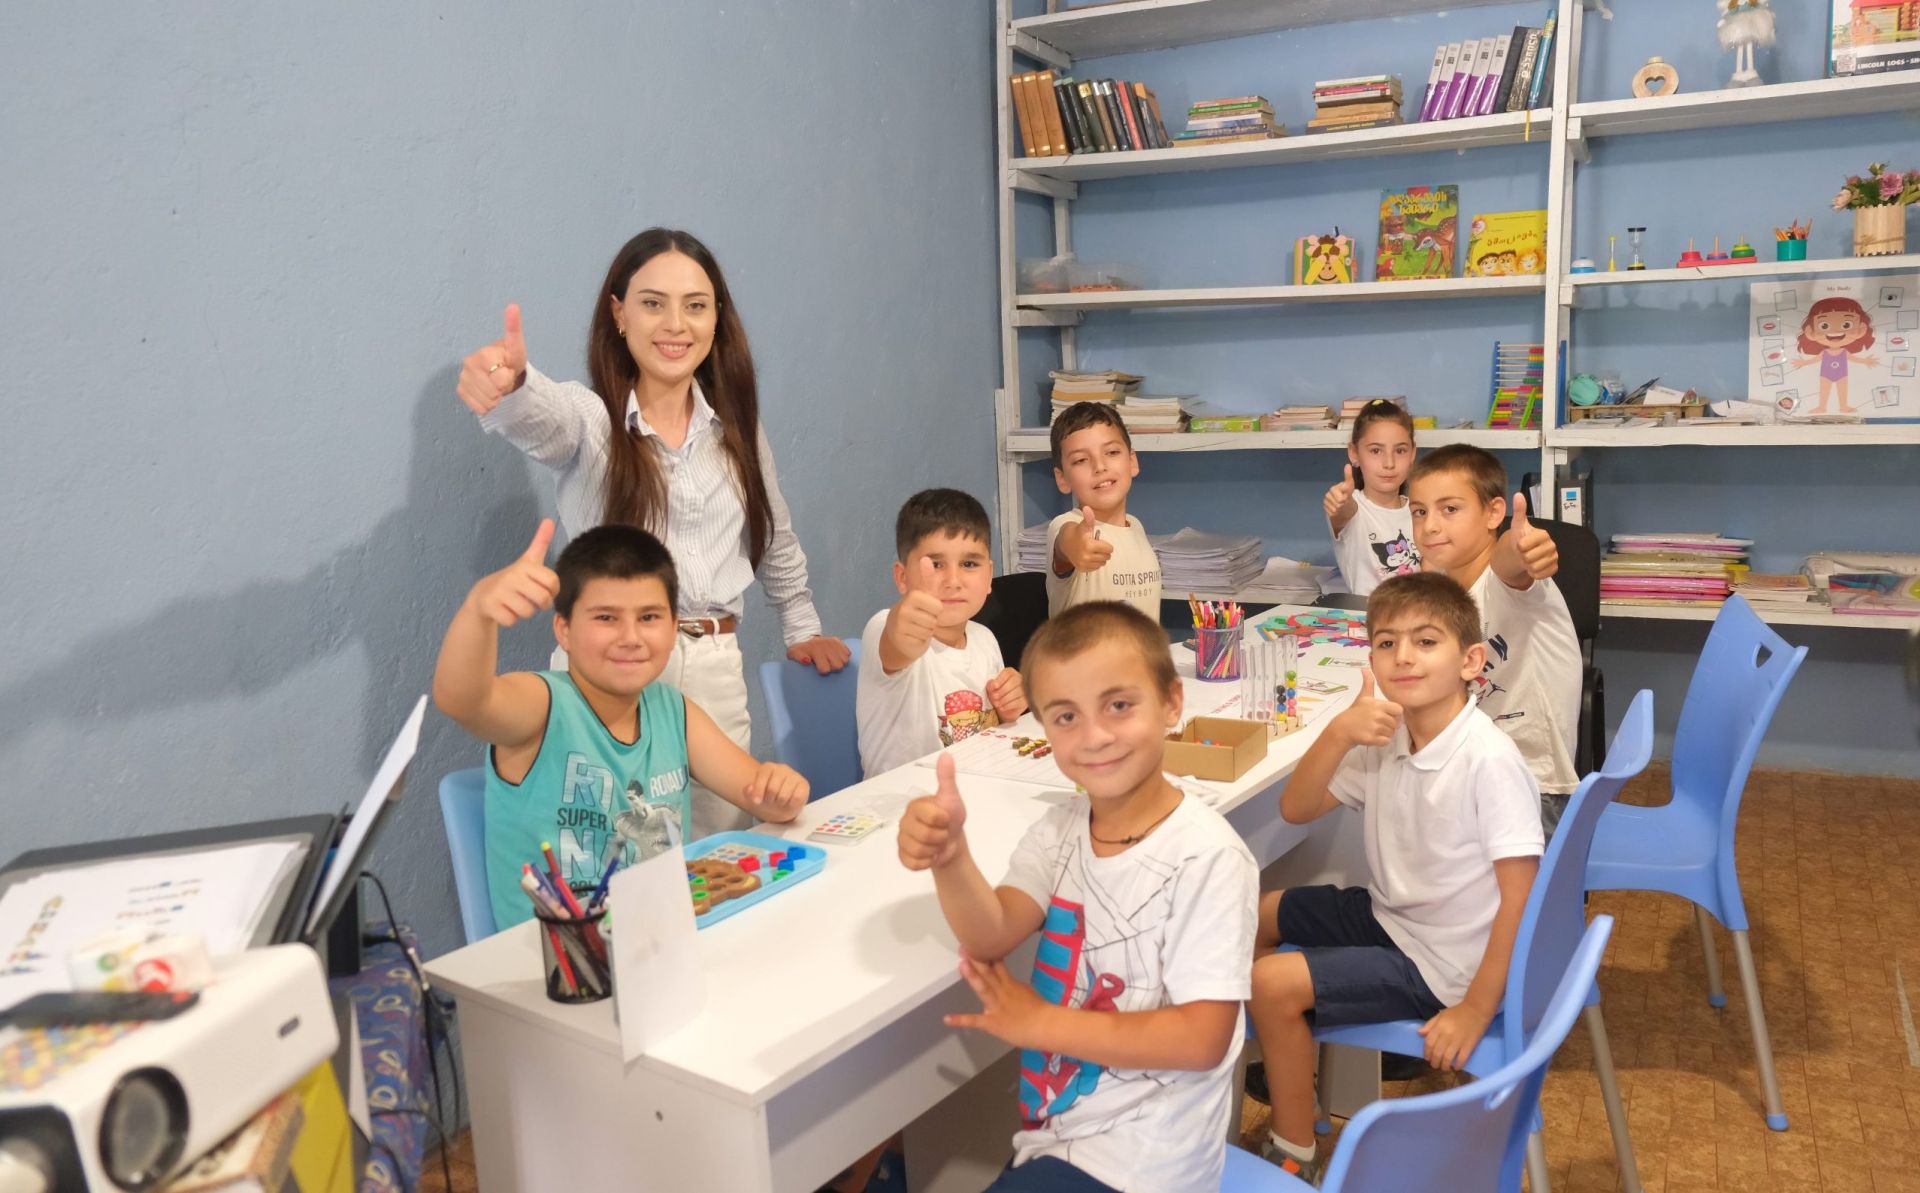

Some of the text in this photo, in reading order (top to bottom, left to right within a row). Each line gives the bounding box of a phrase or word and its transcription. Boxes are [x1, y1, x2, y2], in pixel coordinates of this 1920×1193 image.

[1857, 62, 1885, 70] LINCOLN
[1887, 59, 1906, 67] LOGS
[1112, 573, 1136, 586] GOTTA
[556, 808, 608, 832] SUPER
